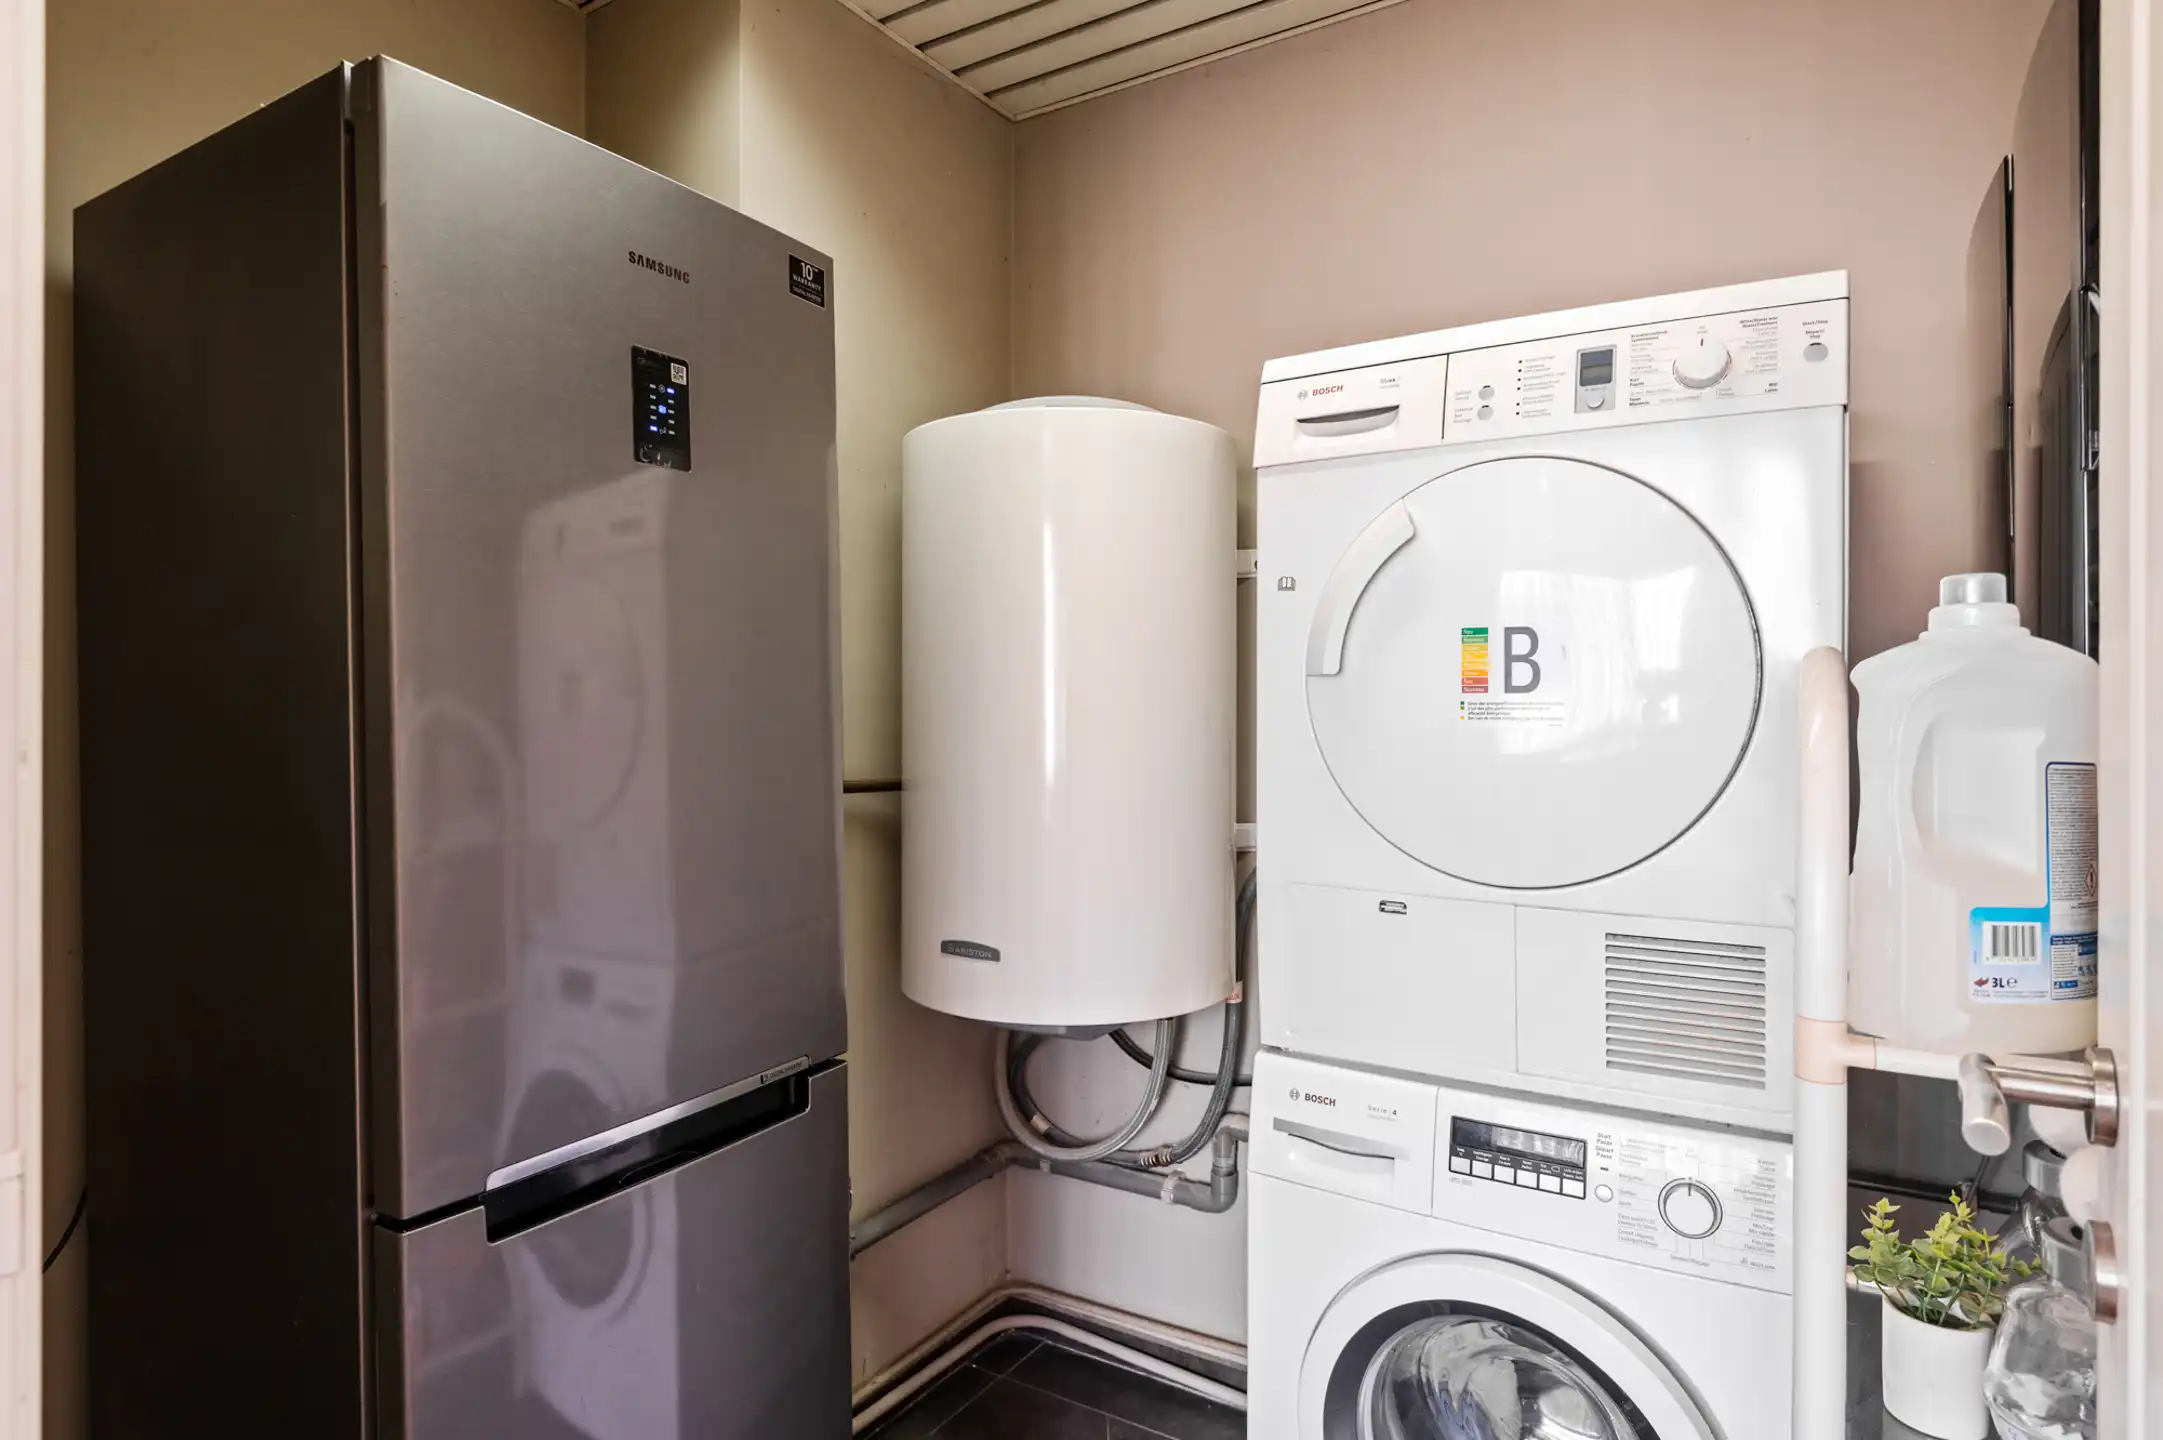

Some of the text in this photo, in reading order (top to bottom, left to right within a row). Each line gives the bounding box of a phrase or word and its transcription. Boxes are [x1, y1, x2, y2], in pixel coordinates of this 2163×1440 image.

[628, 250, 691, 284] SAMSUNG
[800, 262, 813, 281] 10
[1312, 385, 1344, 397] BOSCH
[1504, 626, 1541, 694] B
[954, 946, 992, 959] ARISTON
[1991, 977, 2005, 988] 3L
[1304, 1092, 1337, 1107] BOSCH
[1367, 1104, 1389, 1115] Serie
